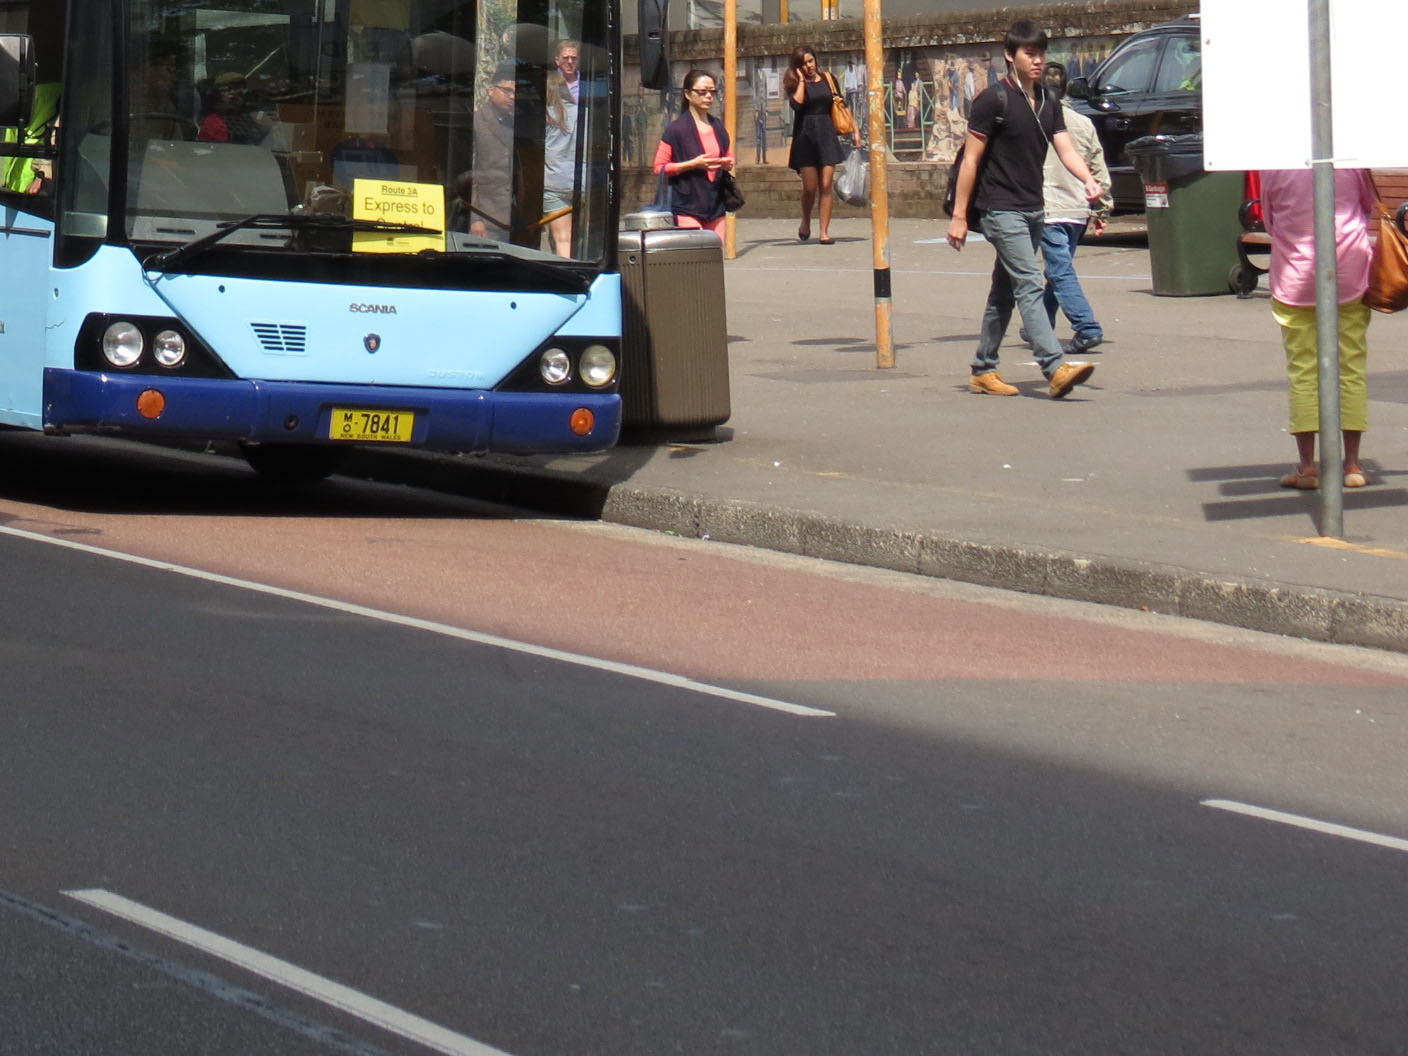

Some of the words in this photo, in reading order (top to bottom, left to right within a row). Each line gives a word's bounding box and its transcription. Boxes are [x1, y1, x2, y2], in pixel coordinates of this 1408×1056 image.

[381, 185, 406, 195] Route
[407, 187, 419, 196] 3A
[364, 196, 419, 215] Express
[422, 201, 436, 216] to
[349, 303, 398, 315] SCANIA
[360, 413, 400, 435] 7841
